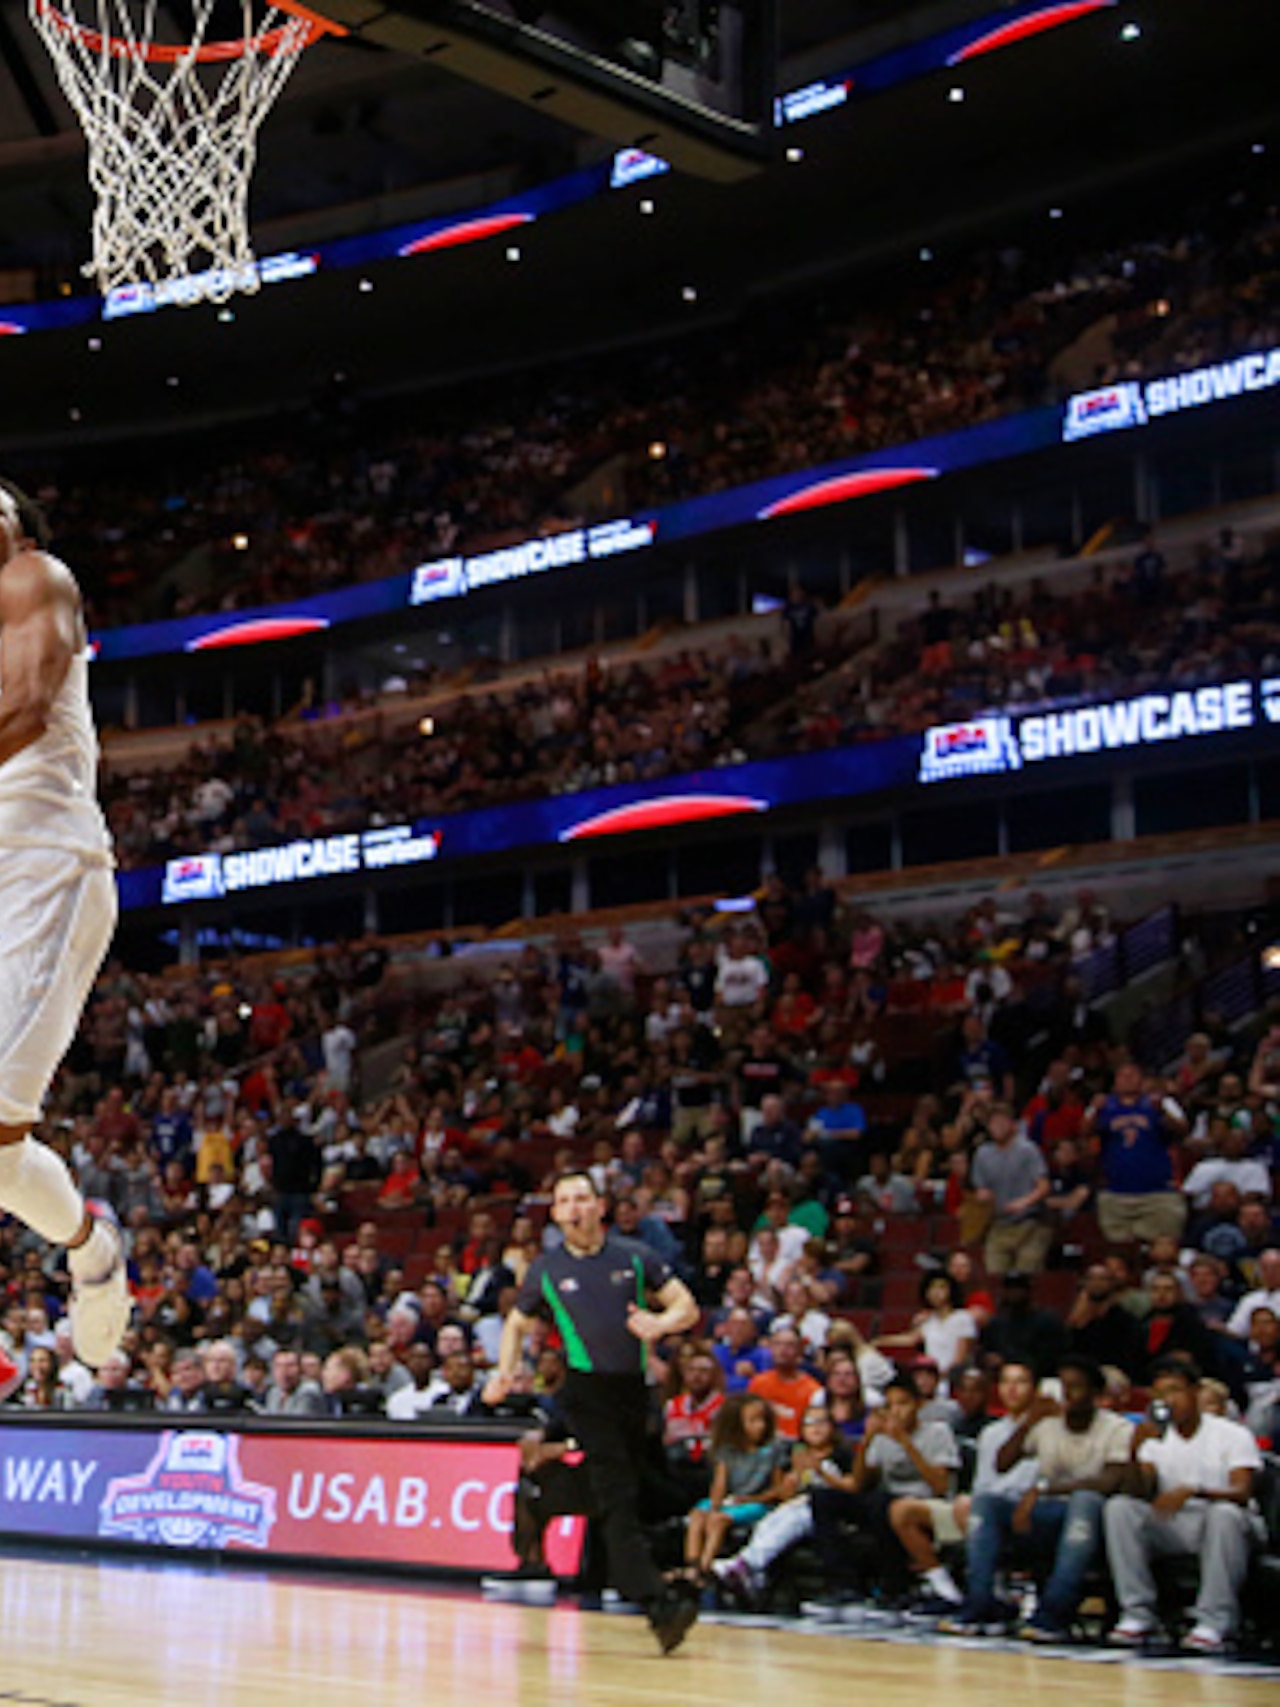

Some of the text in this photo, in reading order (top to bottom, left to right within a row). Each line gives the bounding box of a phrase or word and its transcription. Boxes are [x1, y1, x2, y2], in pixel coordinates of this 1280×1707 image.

[465, 529, 585, 589] SHOWCASE
[1020, 681, 1254, 762] SHOWCASE
[223, 834, 361, 891] SHOWCASE
[3, 1457, 99, 1505] WAY
[115, 1490, 261, 1525] DEVELOPMENT
[287, 1472, 517, 1532] USAB.CO
